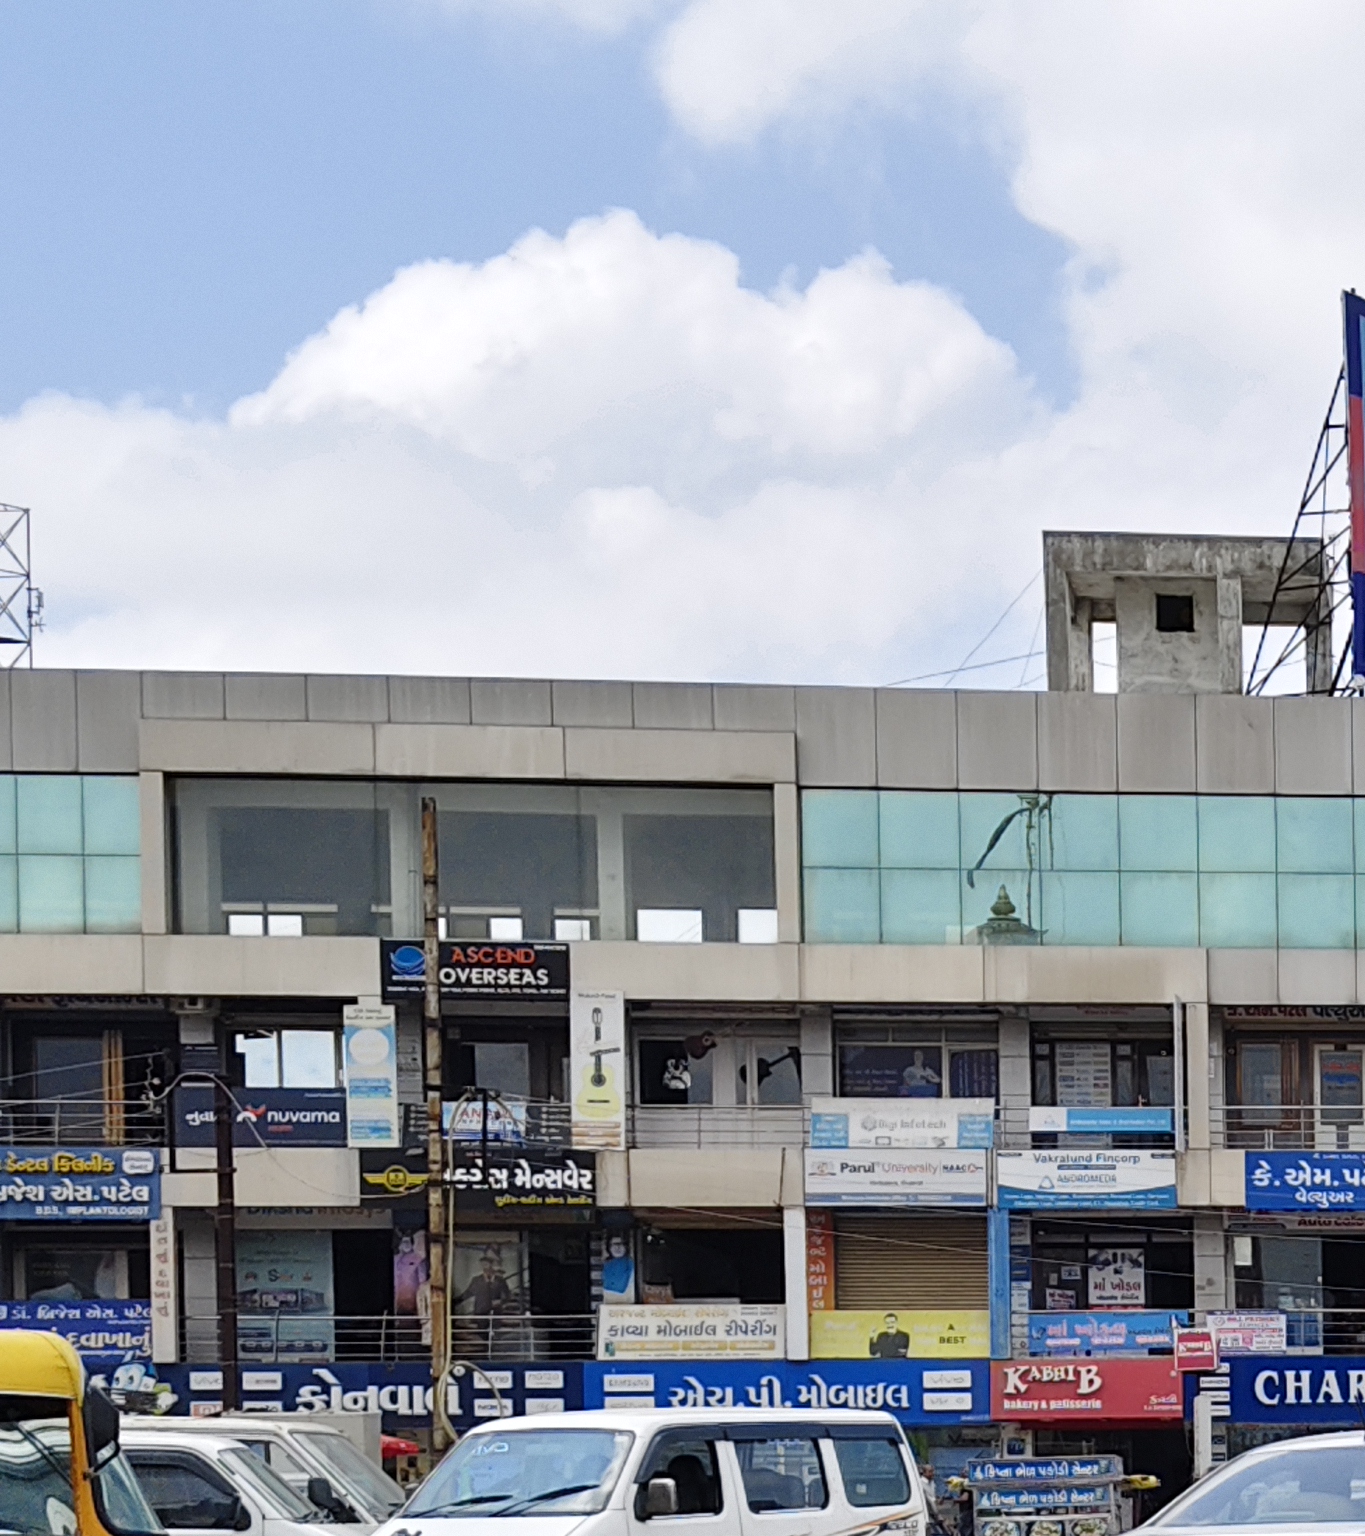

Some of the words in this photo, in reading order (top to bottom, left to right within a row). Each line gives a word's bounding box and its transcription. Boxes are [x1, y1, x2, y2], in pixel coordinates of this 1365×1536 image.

[452, 946, 536, 964] ASCEND
[438, 967, 549, 986] OVERSEAS
[267, 1110, 341, 1123] nuvama
[1096, 1152, 1141, 1164] Fincorp
[514, 1158, 593, 1190] મેન્સવેર
[840, 1161, 876, 1174] Parul
[881, 1161, 938, 1175] University
[101, 1178, 149, 1202] પટેલ
[1294, 1186, 1355, 1208] વેલ્યુઅર
[66, 1205, 149, 1216] IMPLANTOLOGIST
[608, 1323, 649, 1338] કાવ્યા
[656, 1320, 717, 1337] મોબાઈલ
[947, 1323, 955, 1332] A
[938, 1336, 967, 1344] BEST
[1003, 1365, 1077, 1395] KABHI
[1003, 1398, 1039, 1412] bakery
[1041, 1399, 1049, 1410] &
[1049, 1397, 1103, 1411] patisserie
